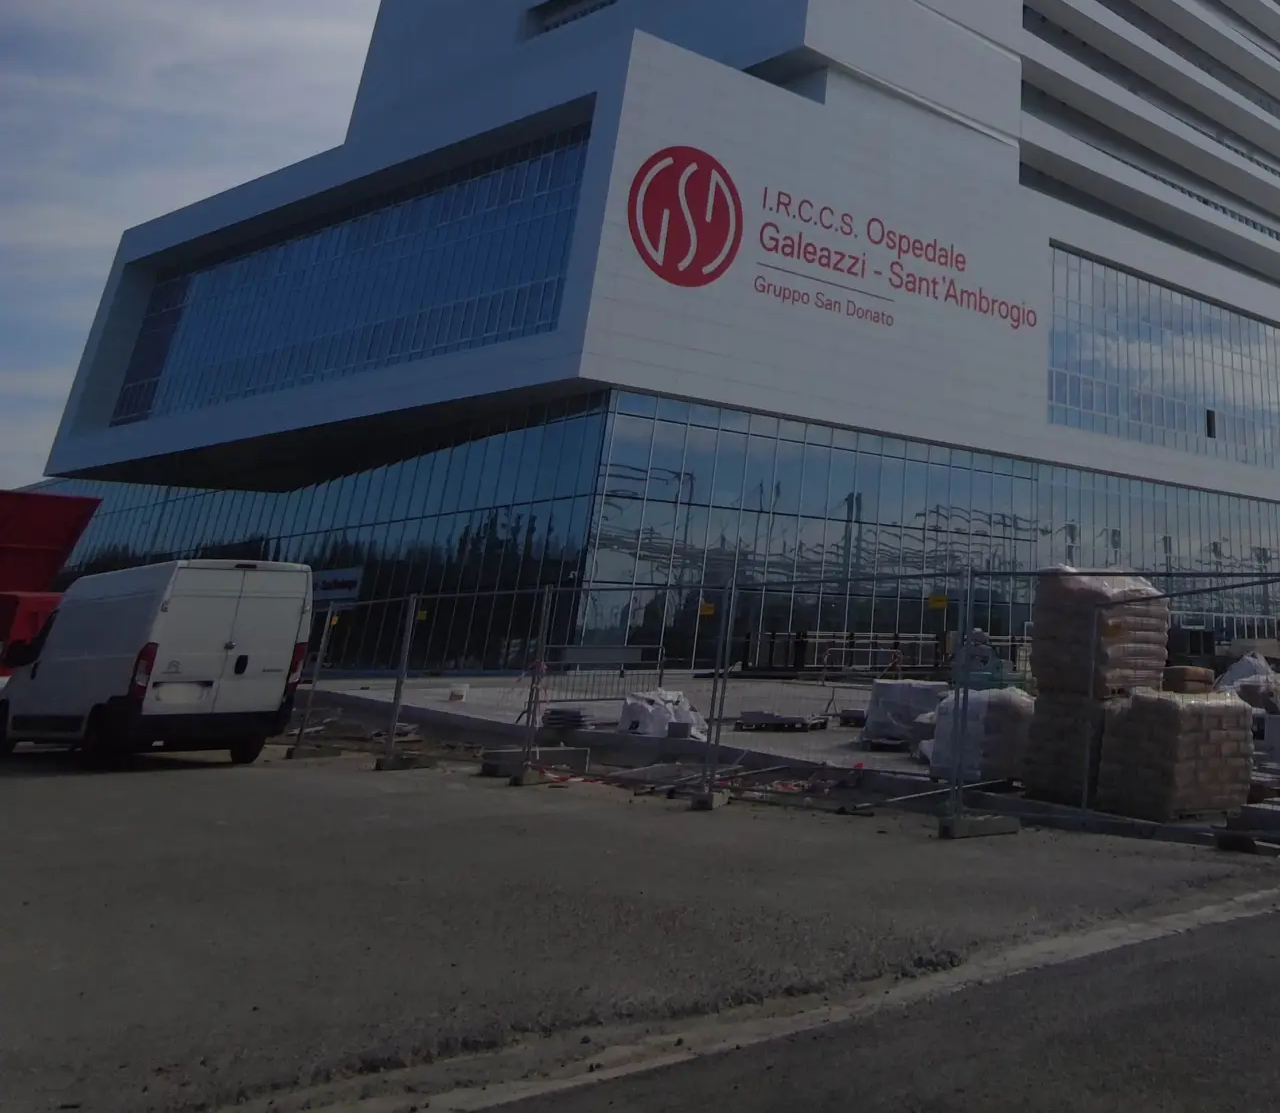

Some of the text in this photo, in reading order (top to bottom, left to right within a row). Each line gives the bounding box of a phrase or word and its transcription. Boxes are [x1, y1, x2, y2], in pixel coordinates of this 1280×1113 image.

[762, 186, 967, 272] I.R.C.C.S. Ospedale
[753, 275, 895, 327] Gruppo San Donato
[758, 222, 867, 279] Galeazzi
[888, 260, 1038, 330] Sant'Ambrogio
